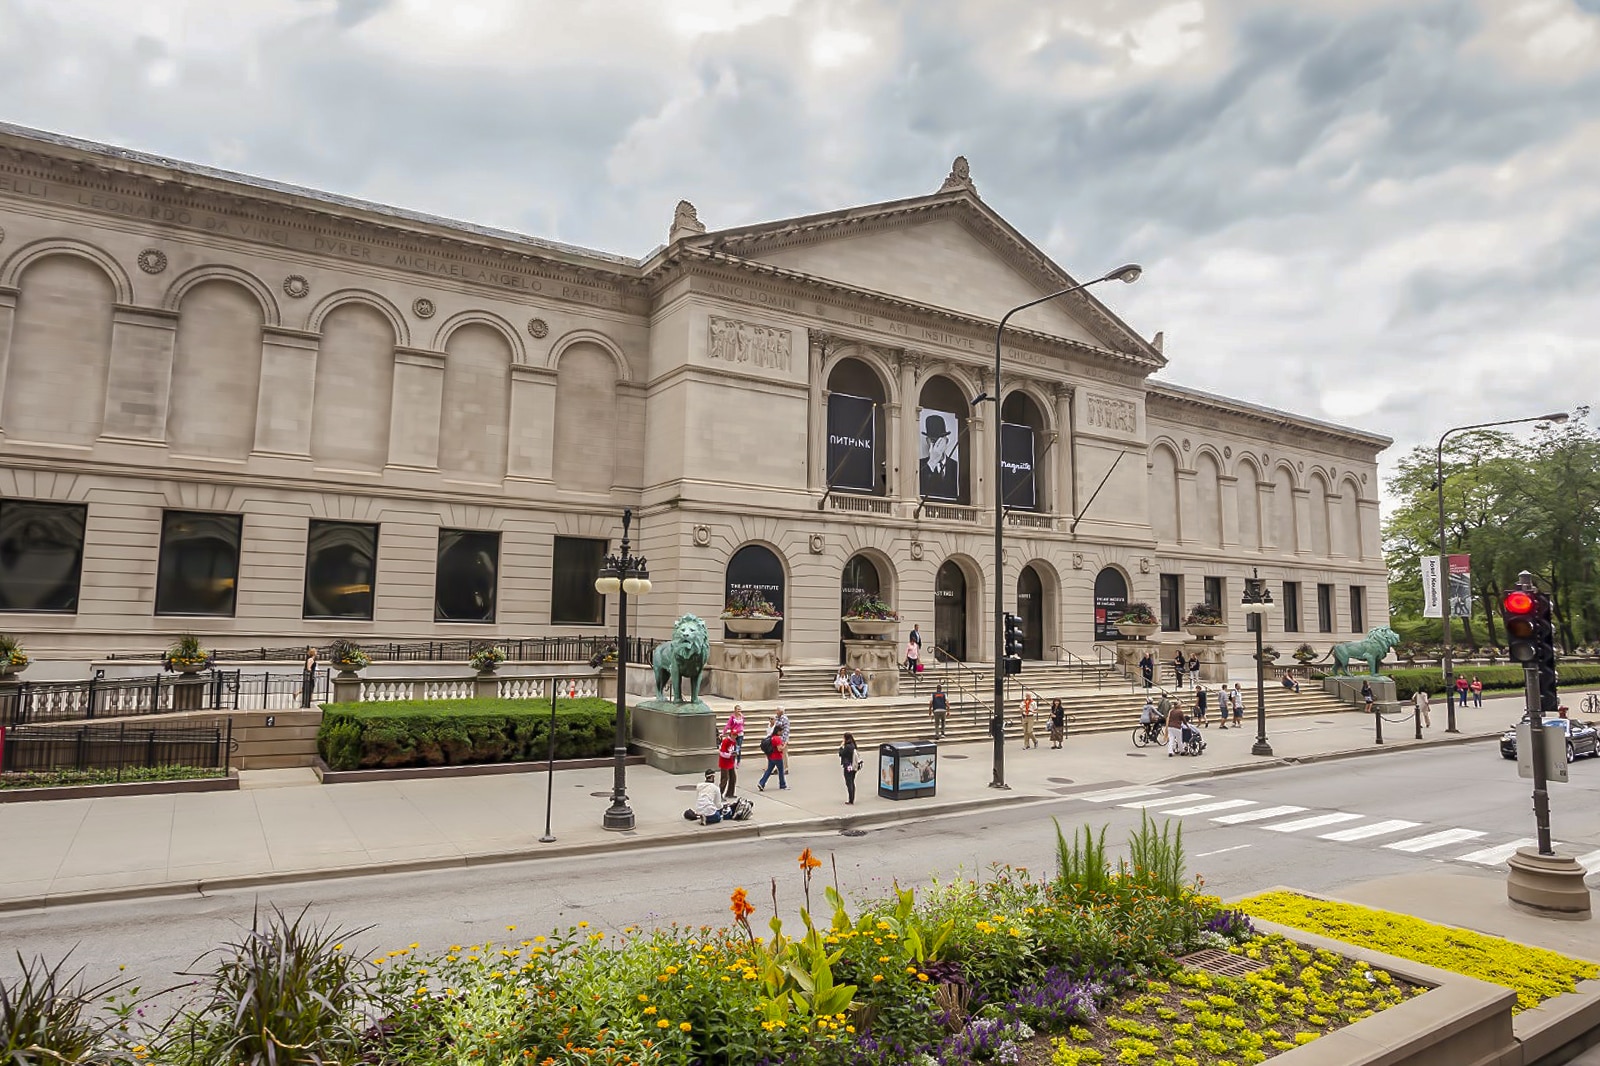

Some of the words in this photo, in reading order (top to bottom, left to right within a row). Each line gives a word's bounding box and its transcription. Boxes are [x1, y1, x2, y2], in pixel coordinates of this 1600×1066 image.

[77, 192, 192, 225] LEONARDO
[204, 216, 229, 232] DA
[240, 225, 289, 243] VINCI
[314, 238, 371, 259] DVRER
[395, 255, 472, 278] MICHAEL
[478, 270, 542, 292] ANGELO
[562, 286, 625, 308] RAPHAEL
[708, 283, 743, 298] ANNO
[749, 291, 796, 310] DOMINI
[854, 314, 874, 327] THE
[889, 322, 909, 335] ART
